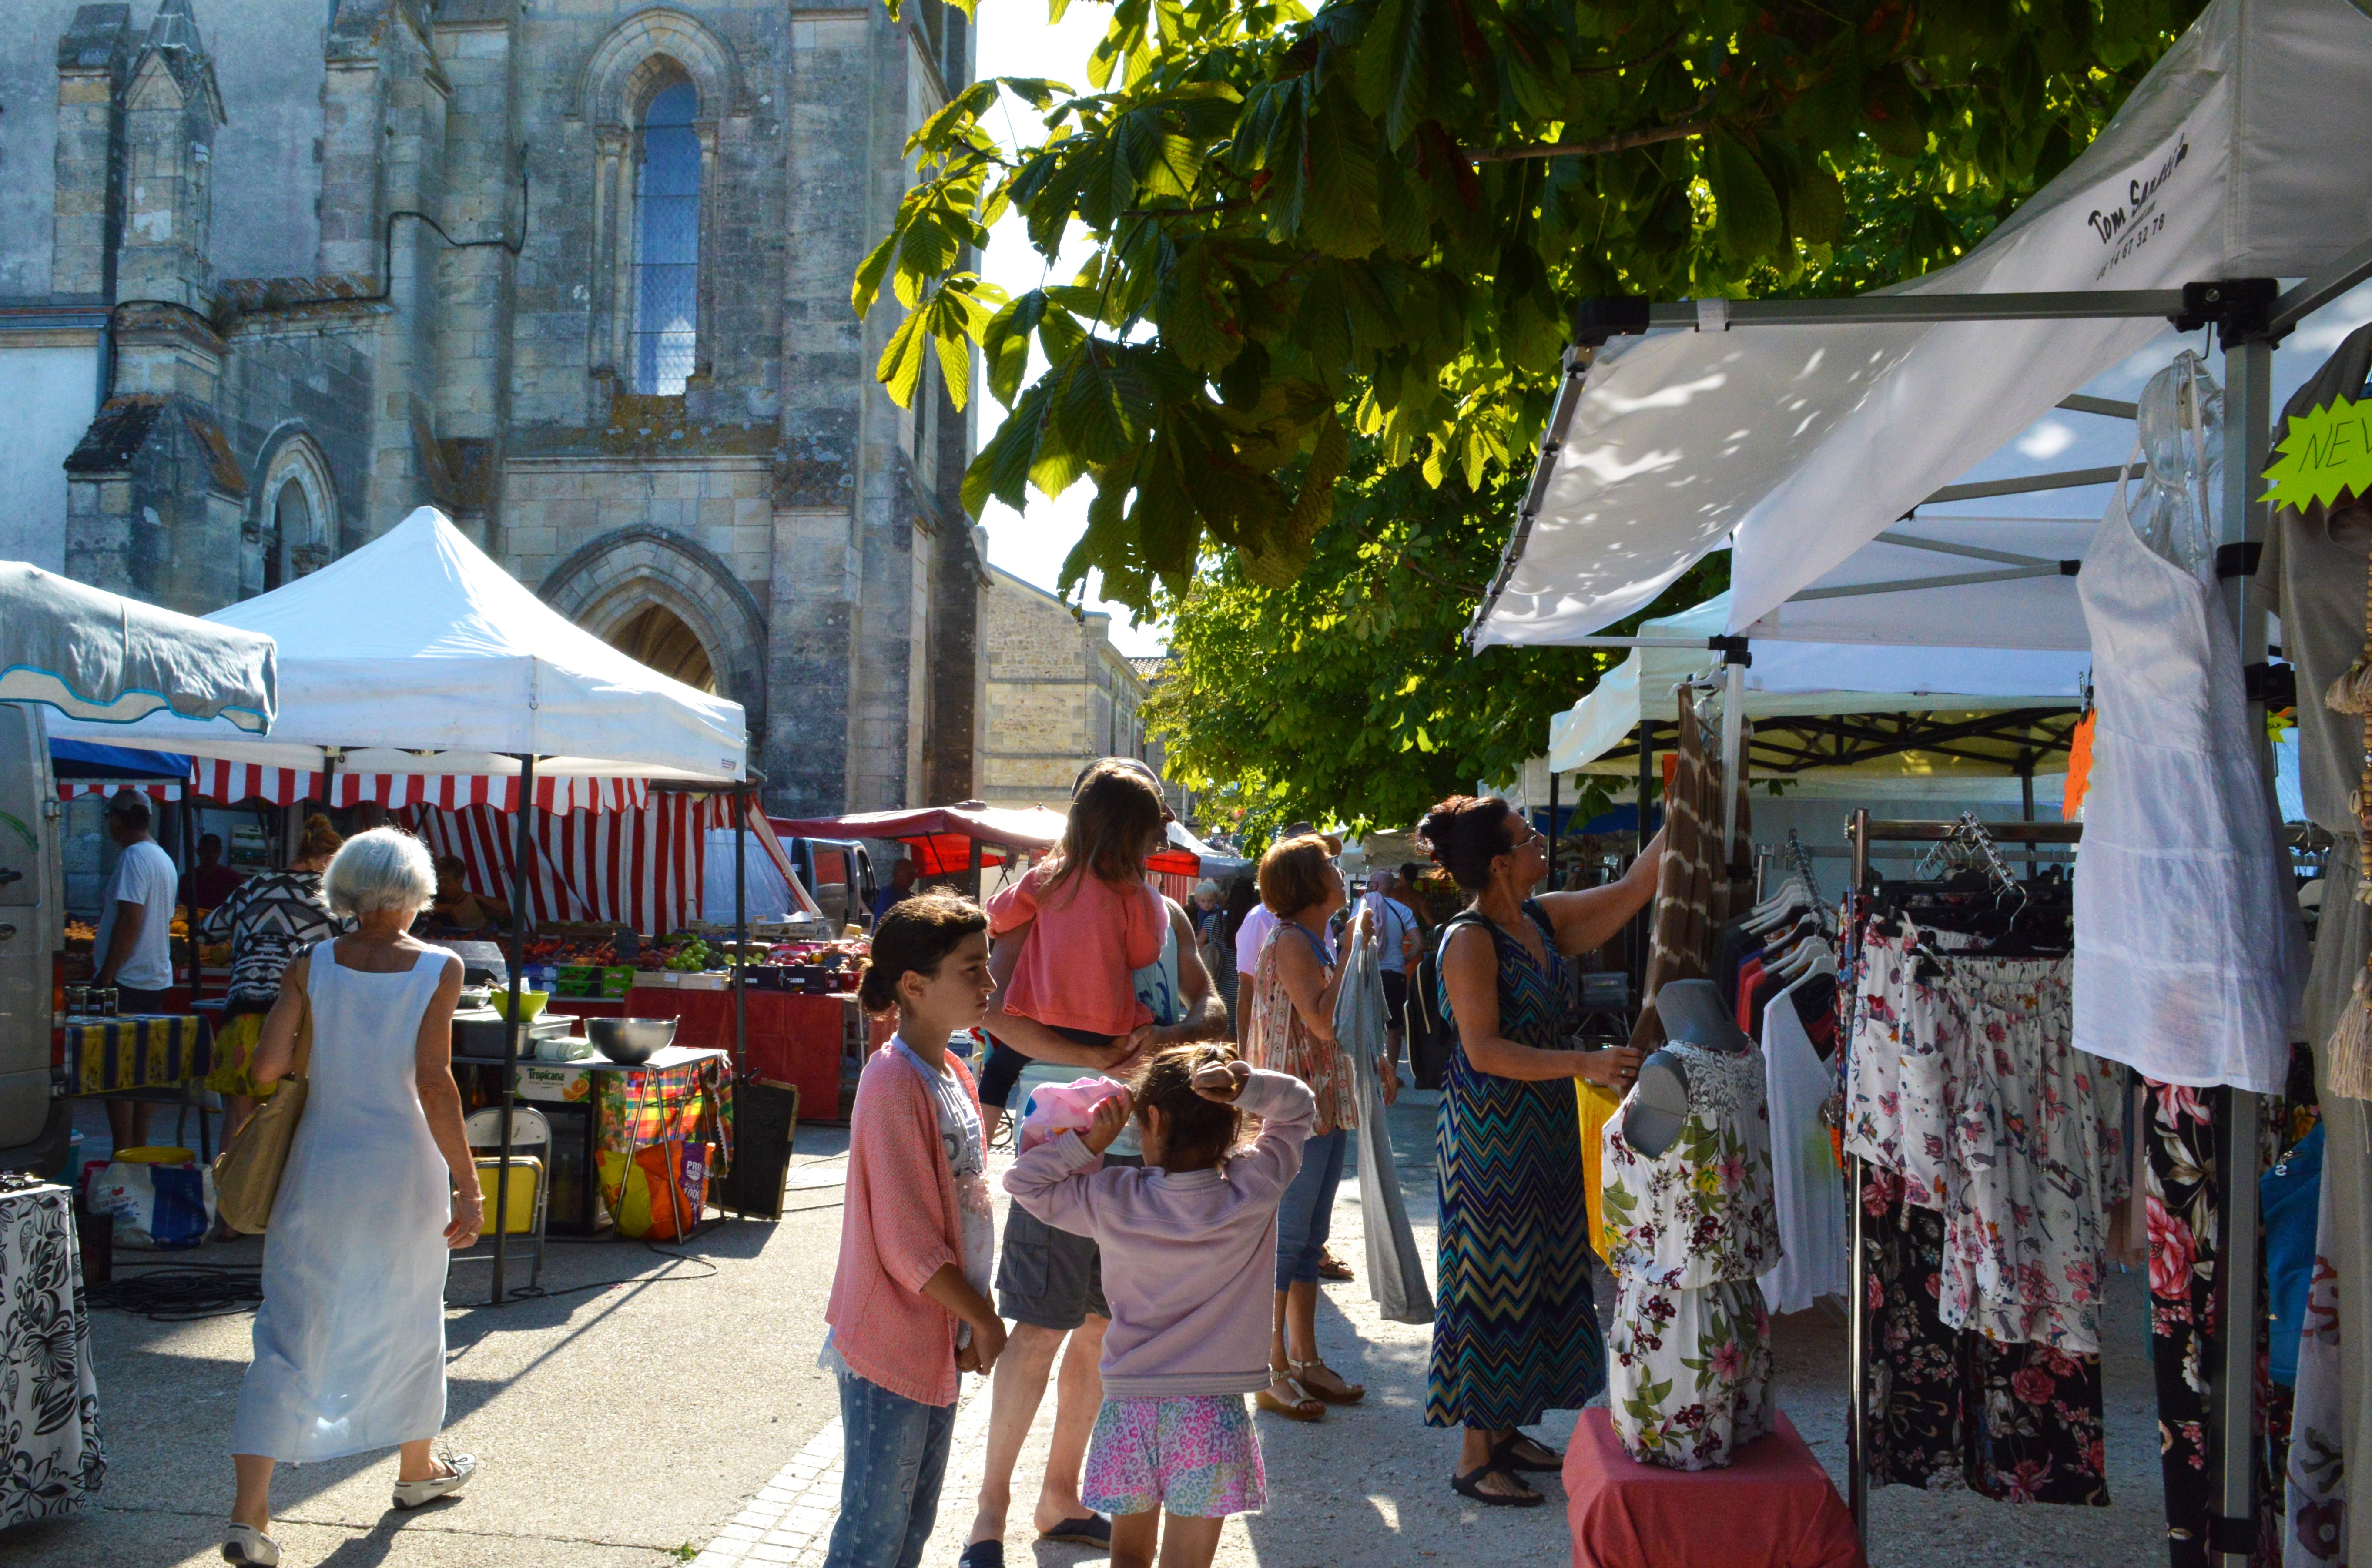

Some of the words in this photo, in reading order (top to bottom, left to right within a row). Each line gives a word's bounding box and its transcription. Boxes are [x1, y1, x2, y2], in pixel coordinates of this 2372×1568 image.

[2089, 207, 2126, 244] Tom
[2122, 238, 2134, 259] 67
[2137, 226, 2148, 248] 32
[2152, 213, 2165, 235] 78
[527, 1067, 564, 1081] Tropicana
